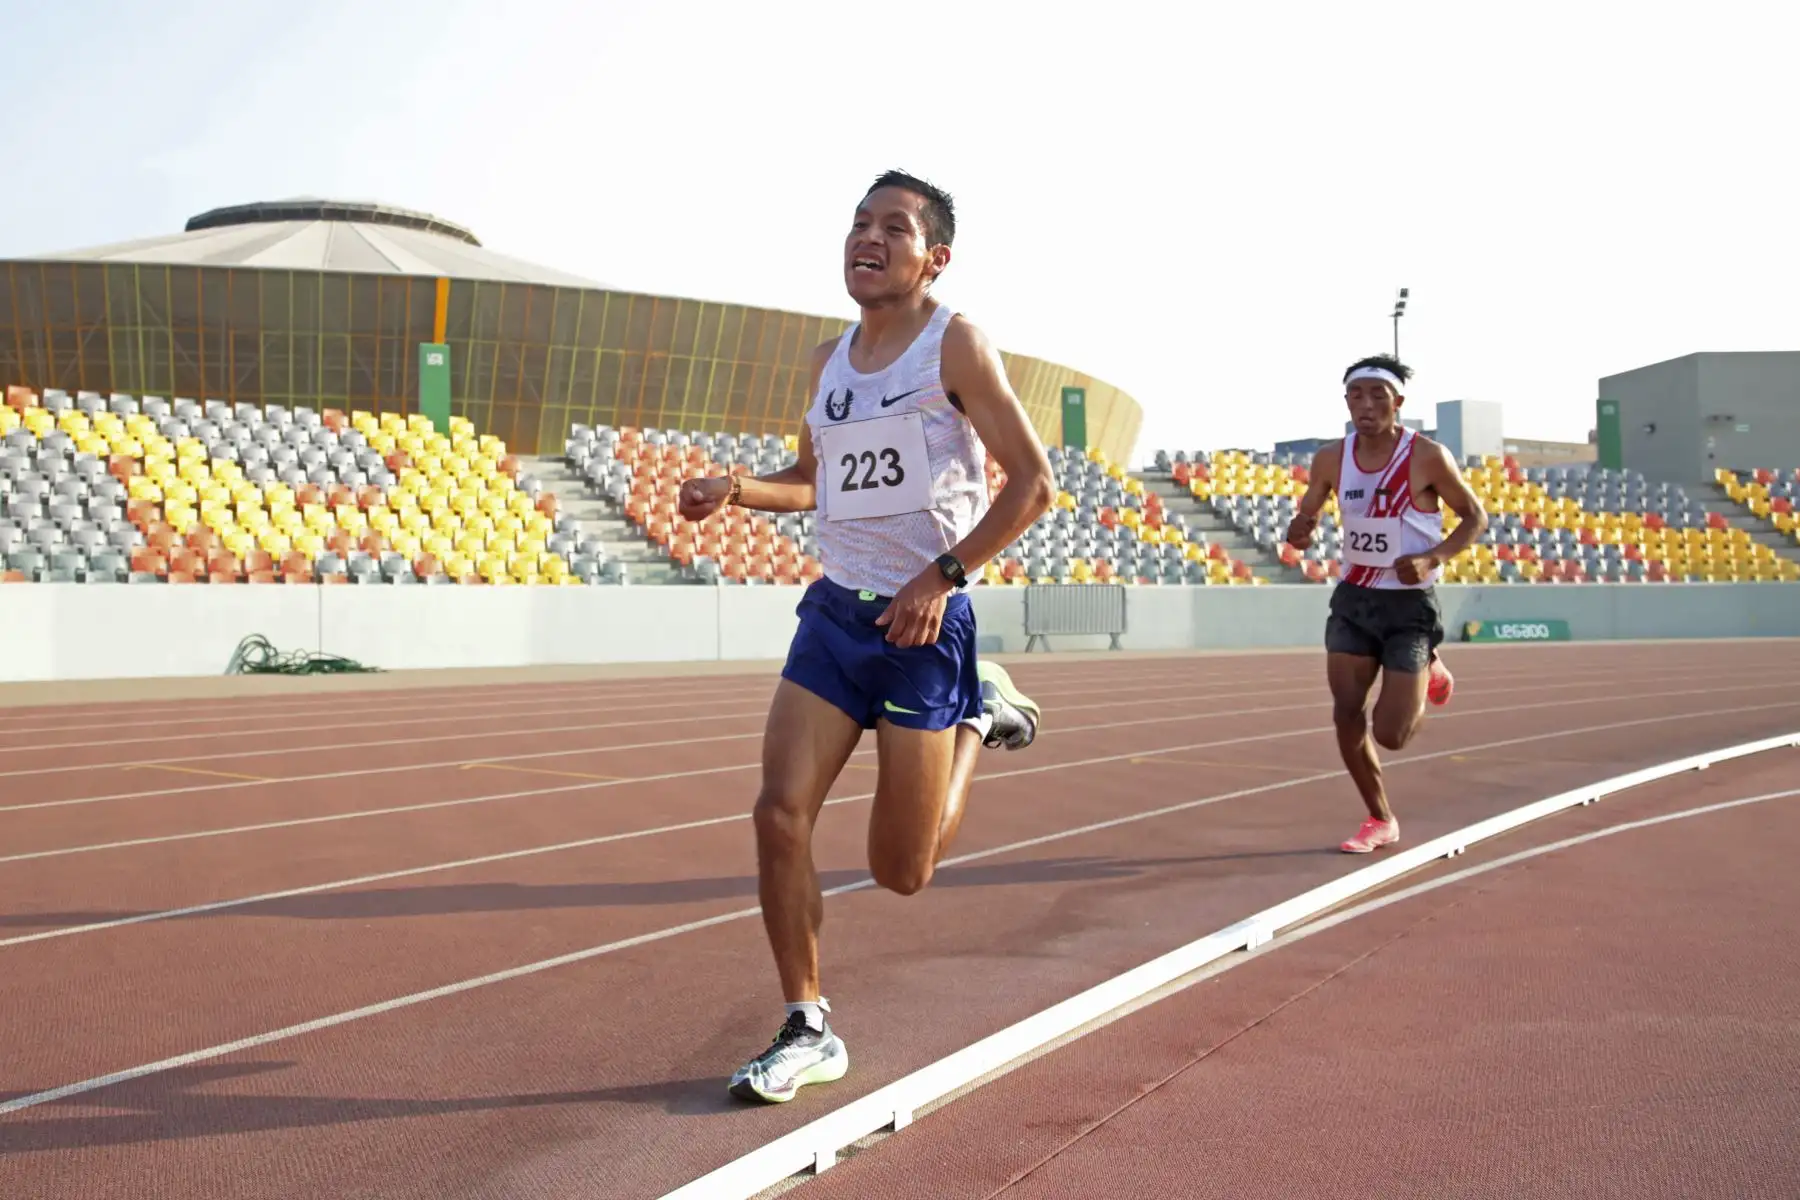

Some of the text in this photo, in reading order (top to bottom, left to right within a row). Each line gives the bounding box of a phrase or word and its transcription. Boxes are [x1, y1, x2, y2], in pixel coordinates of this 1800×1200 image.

[840, 447, 905, 492] 223
[1344, 488, 1365, 500] PERU
[1349, 530, 1389, 553] 225
